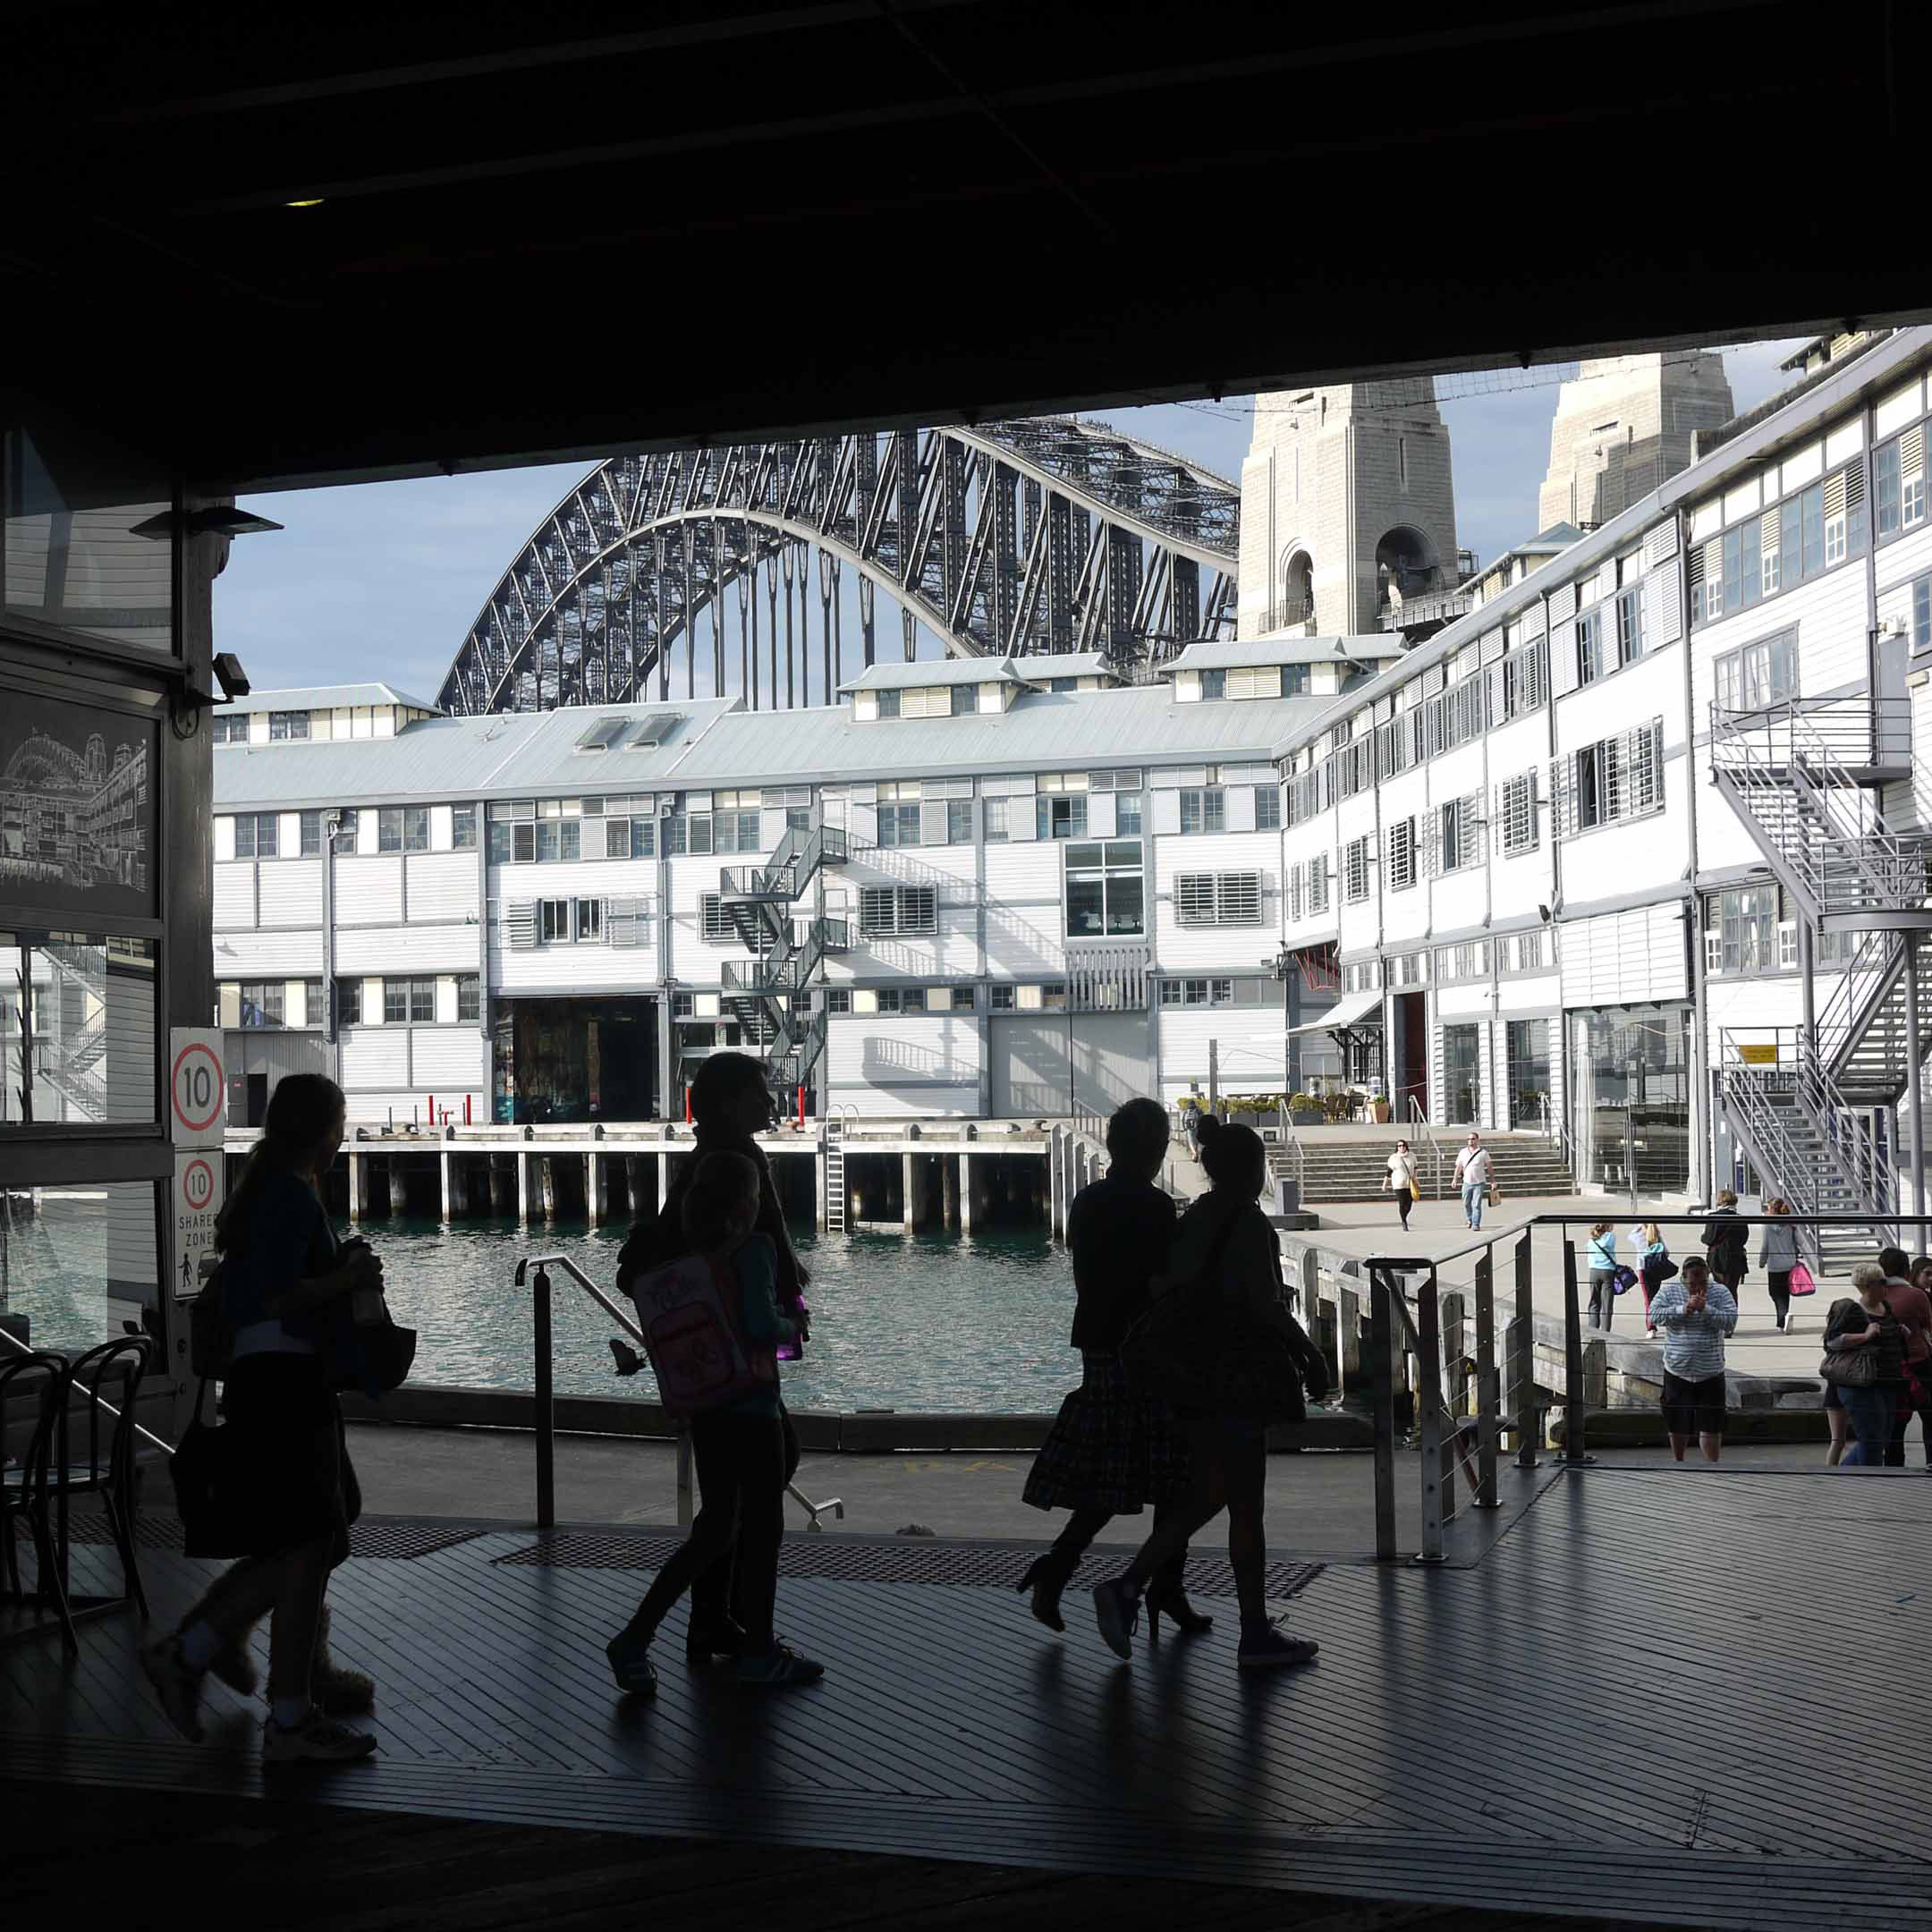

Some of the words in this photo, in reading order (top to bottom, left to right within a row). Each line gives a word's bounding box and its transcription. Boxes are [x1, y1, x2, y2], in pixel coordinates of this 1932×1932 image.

[184, 1066, 210, 1108] 10
[191, 1173, 206, 1195] 10
[185, 1232, 213, 1247] ZONE
